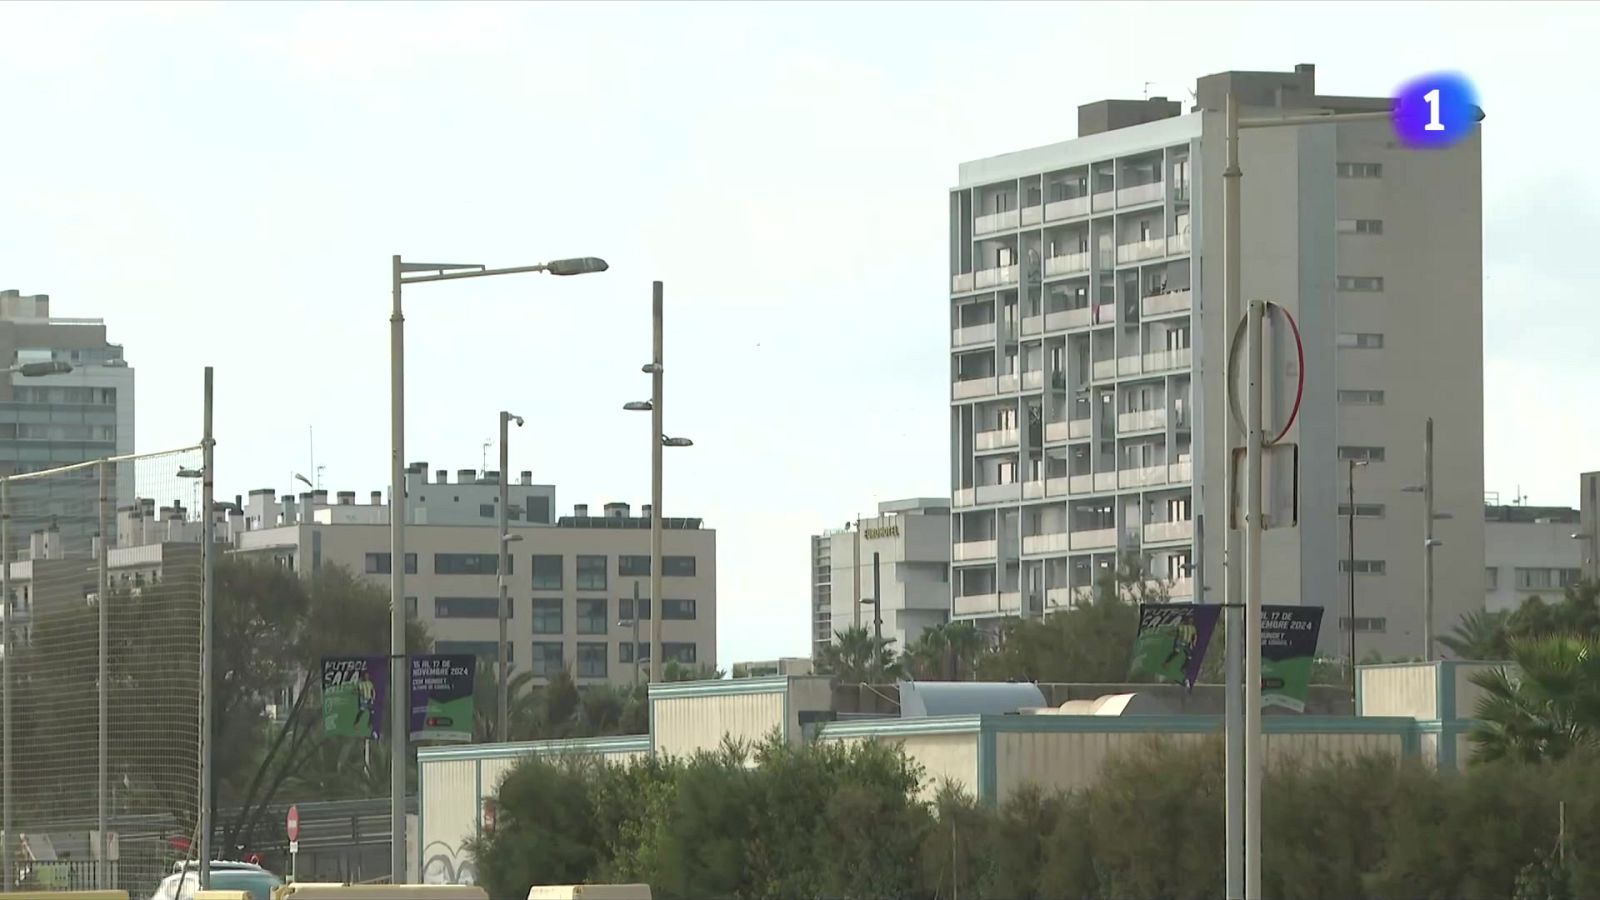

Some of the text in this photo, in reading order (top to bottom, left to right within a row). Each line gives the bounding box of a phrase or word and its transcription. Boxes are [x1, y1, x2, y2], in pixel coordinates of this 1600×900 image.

[1290, 621, 1312, 630] 2024
[413, 667, 469, 676] NOVEMBRE 2024
[325, 670, 359, 685] SALA
